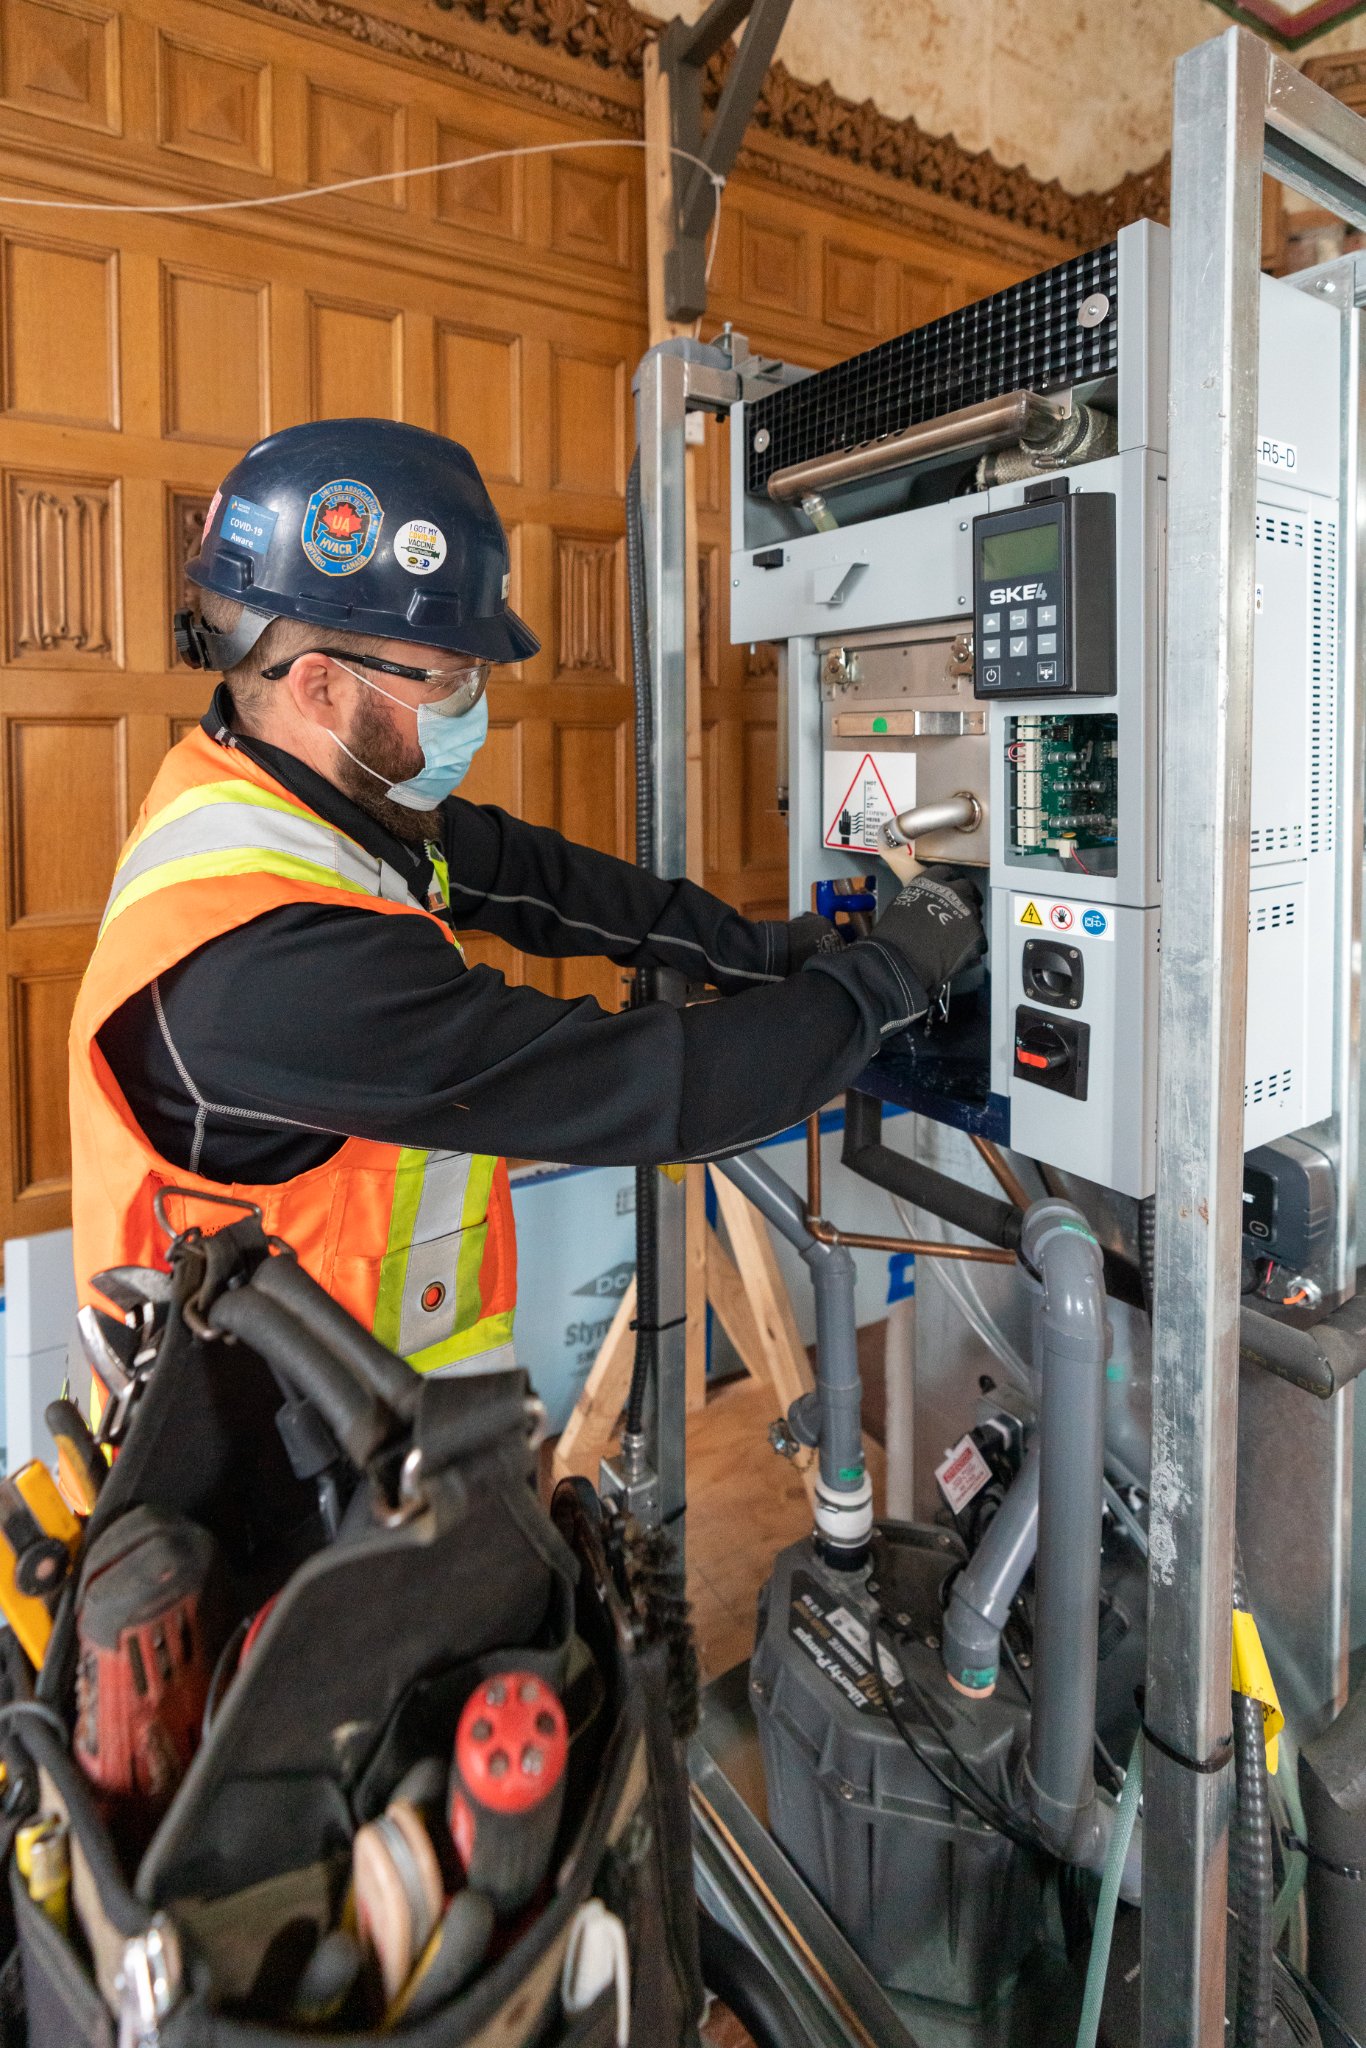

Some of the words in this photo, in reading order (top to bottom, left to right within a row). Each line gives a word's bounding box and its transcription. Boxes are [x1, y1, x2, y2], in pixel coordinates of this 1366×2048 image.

[319, 485, 343, 499] UNITED
[343, 485, 379, 514] ASSOCIATION
[230, 517, 263, 537] COVID-19
[332, 515, 350, 533] UA
[413, 524, 428, 534] GOT
[428, 527, 438, 536] MY
[230, 532, 254, 548] Aware
[319, 537, 353, 554] HVACR
[408, 531, 437, 544] COVID-19
[408, 538, 436, 551] VACCINE
[305, 541, 326, 567] ONTARIO
[341, 555, 368, 572] CANADA
[989, 582, 1048, 605] SKE4
[927, 903, 953, 926] CE
[792, 1626, 832, 1669] Pumps
[826, 1663, 869, 1708] Liberty
